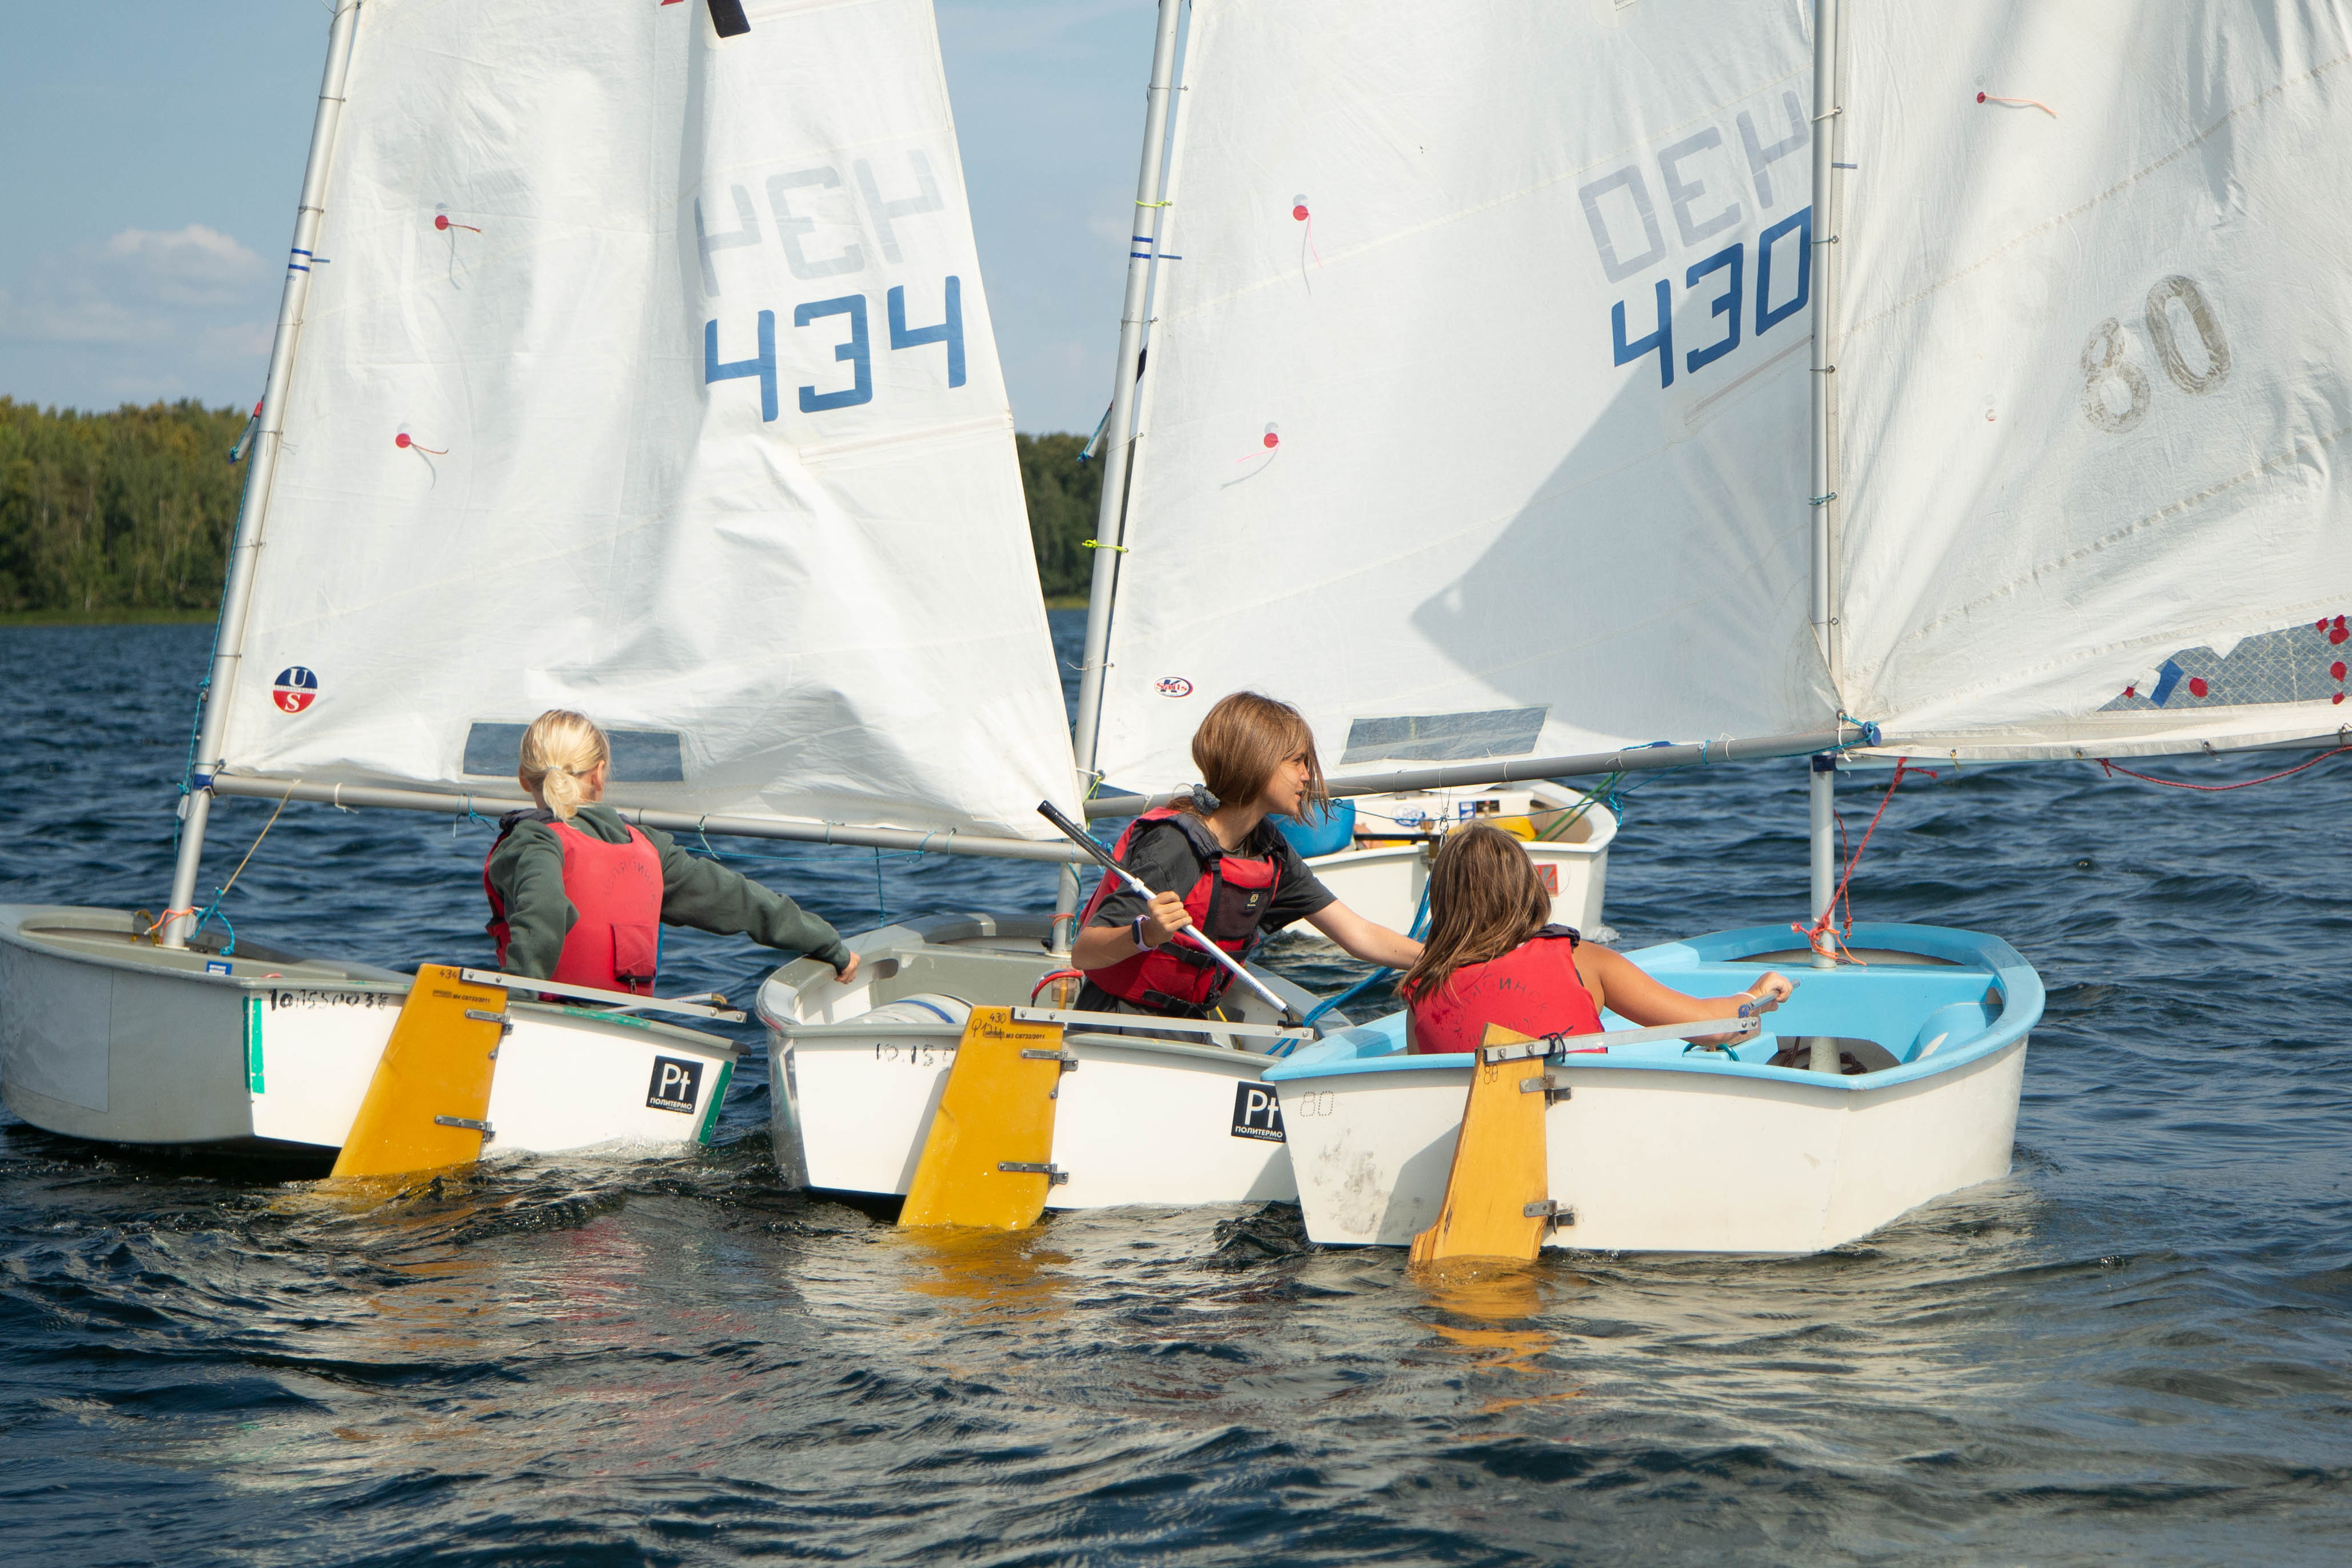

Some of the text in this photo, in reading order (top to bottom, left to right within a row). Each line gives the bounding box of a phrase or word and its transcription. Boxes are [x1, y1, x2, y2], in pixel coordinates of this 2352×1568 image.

[1611, 204, 1812, 389] 430
[704, 275, 967, 423] 434
[2080, 274, 2232, 434] 80
[439, 969, 457, 979] 434
[989, 1012, 1007, 1024] 430
[658, 1062, 691, 1101] Pt
[649, 1097, 693, 1110] ПОЛИТЕРМО
[1244, 1088, 1279, 1128] Pt
[1299, 1090, 1334, 1117] 80
[1235, 1126, 1283, 1138] ПОЛИТЕРМО
